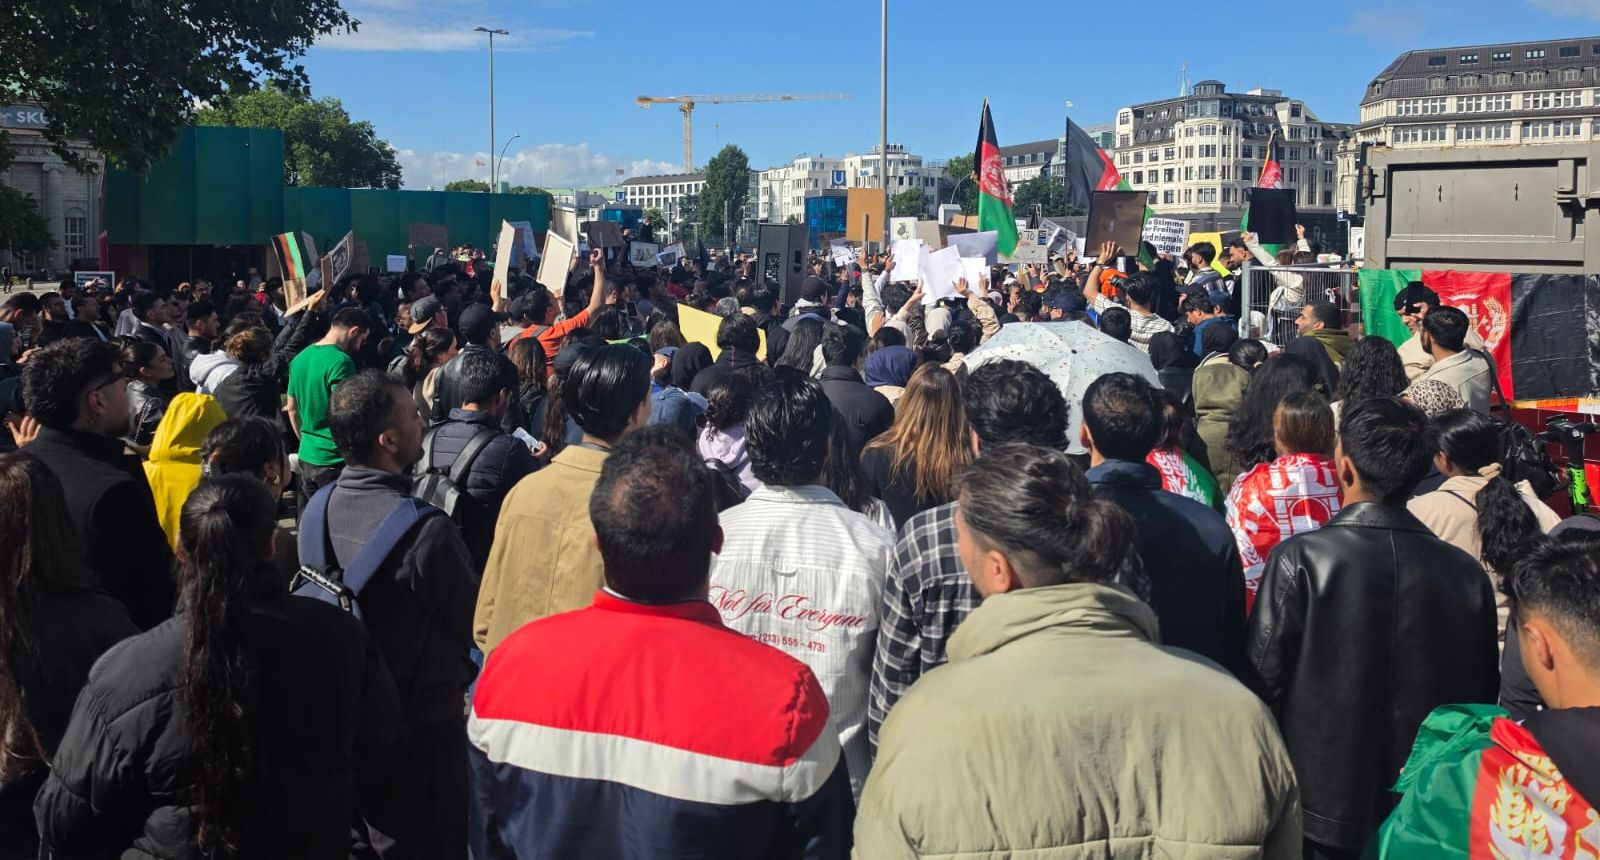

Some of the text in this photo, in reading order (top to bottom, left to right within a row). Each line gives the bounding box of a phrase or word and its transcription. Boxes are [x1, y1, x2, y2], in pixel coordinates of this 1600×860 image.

[834, 172, 844, 184] U
[617, 192, 624, 201] U
[1154, 219, 1185, 227] Stimme
[1153, 226, 1184, 234] Freiheit
[1154, 234, 1183, 243] niemals
[709, 586, 869, 631] Not for Everyone
[759, 633, 780, 645] (213)
[782, 636, 798, 648] 555
[807, 641, 825, 652] 4731
